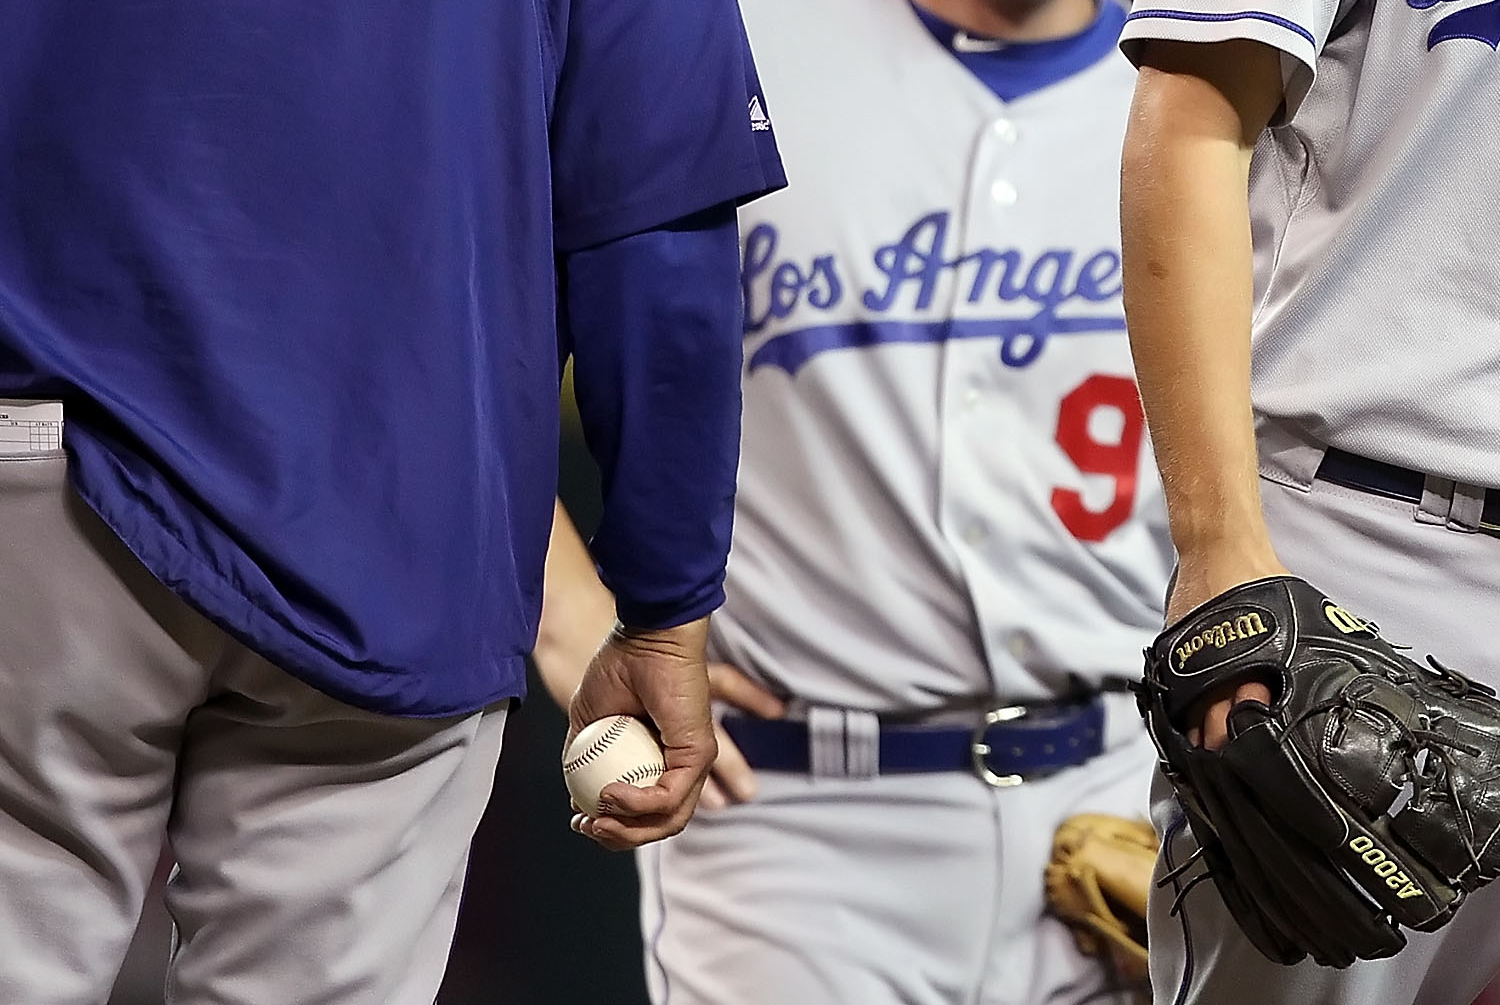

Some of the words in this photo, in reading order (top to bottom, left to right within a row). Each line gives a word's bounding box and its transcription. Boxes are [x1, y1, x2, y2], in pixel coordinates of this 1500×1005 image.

[863, 210, 1124, 369] Ange
[1050, 373, 1145, 544] 9
[1176, 612, 1268, 663] Wilson
[1349, 836, 1424, 899] A2000
